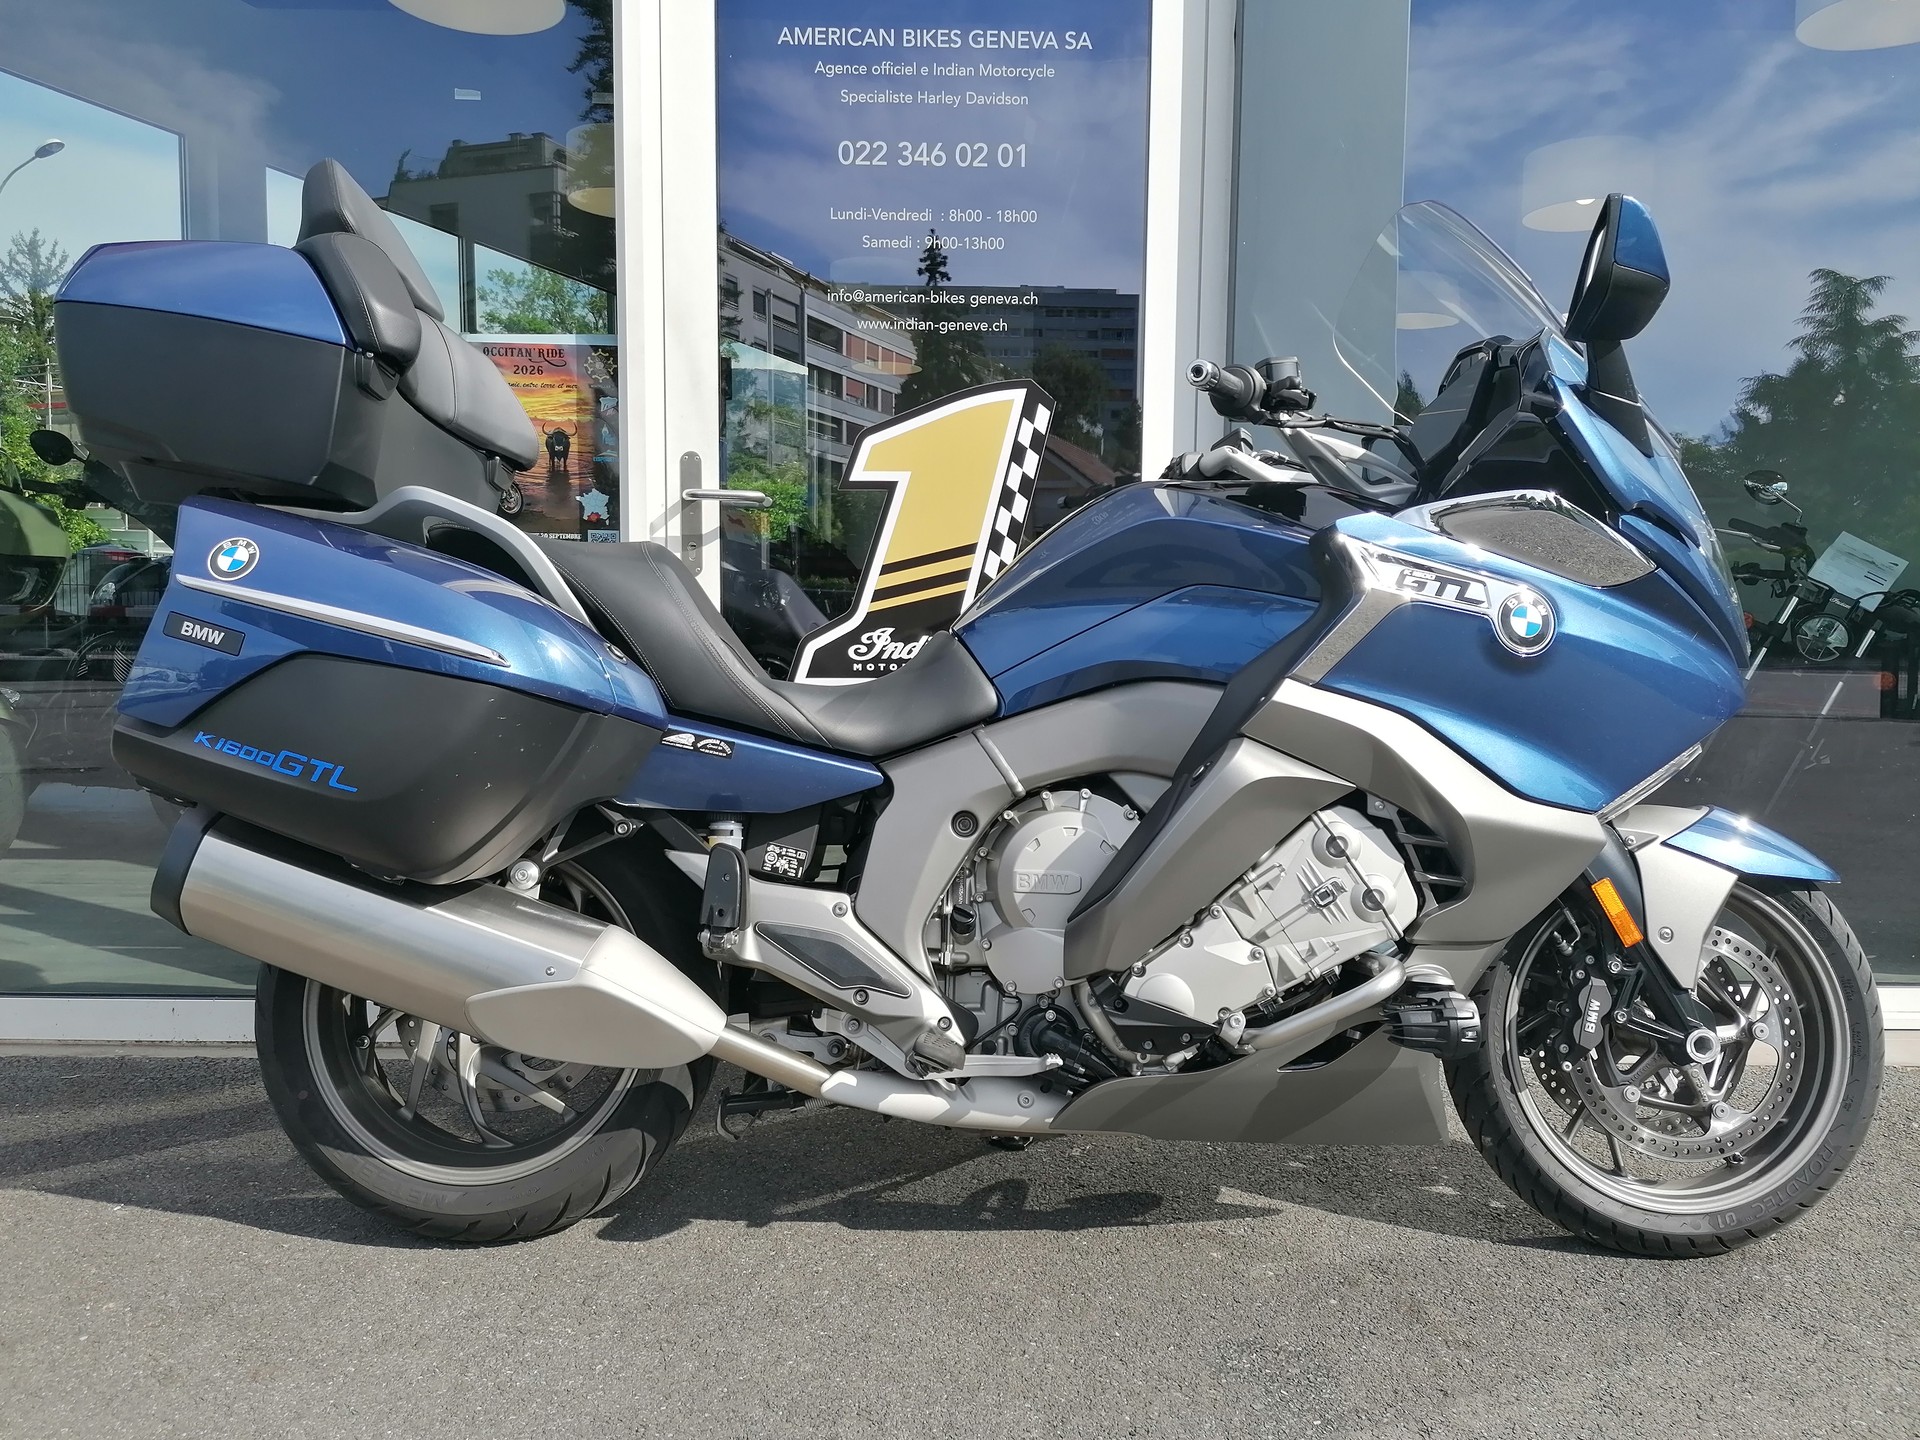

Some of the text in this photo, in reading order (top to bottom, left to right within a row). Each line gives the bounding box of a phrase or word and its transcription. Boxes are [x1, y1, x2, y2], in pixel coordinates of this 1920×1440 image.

[777, 27, 1093, 50] AMERICAN BIKES GENEVA SA
[814, 61, 868, 77] Agence
[871, 61, 917, 76] officiel
[933, 63, 975, 77] Indian
[979, 64, 1055, 80] Motorcycle
[840, 89, 1029, 108] Specialiste Harley Davidson
[837, 140, 1027, 168] 022 346 02 01
[830, 207, 933, 222] Lundi-Vendredi
[949, 209, 983, 223] 8h00
[997, 209, 1038, 223] 18h00
[862, 235, 912, 249] Samedi
[924, 236, 1005, 251] 9h00-13h00
[827, 289, 1039, 307] info@american-bikes geneva.ch
[857, 318, 1008, 334] www.indian-geneve.ch
[513, 365, 543, 375] 2026
[223, 540, 257, 554] BMW
[1395, 568, 1486, 605] GTL
[180, 621, 225, 646] BMW
[847, 627, 933, 661] Ind
[1017, 873, 1070, 891] BMW
[1584, 999, 1601, 1034] BMW
[1750, 1143, 1834, 1219] ROADTEC
